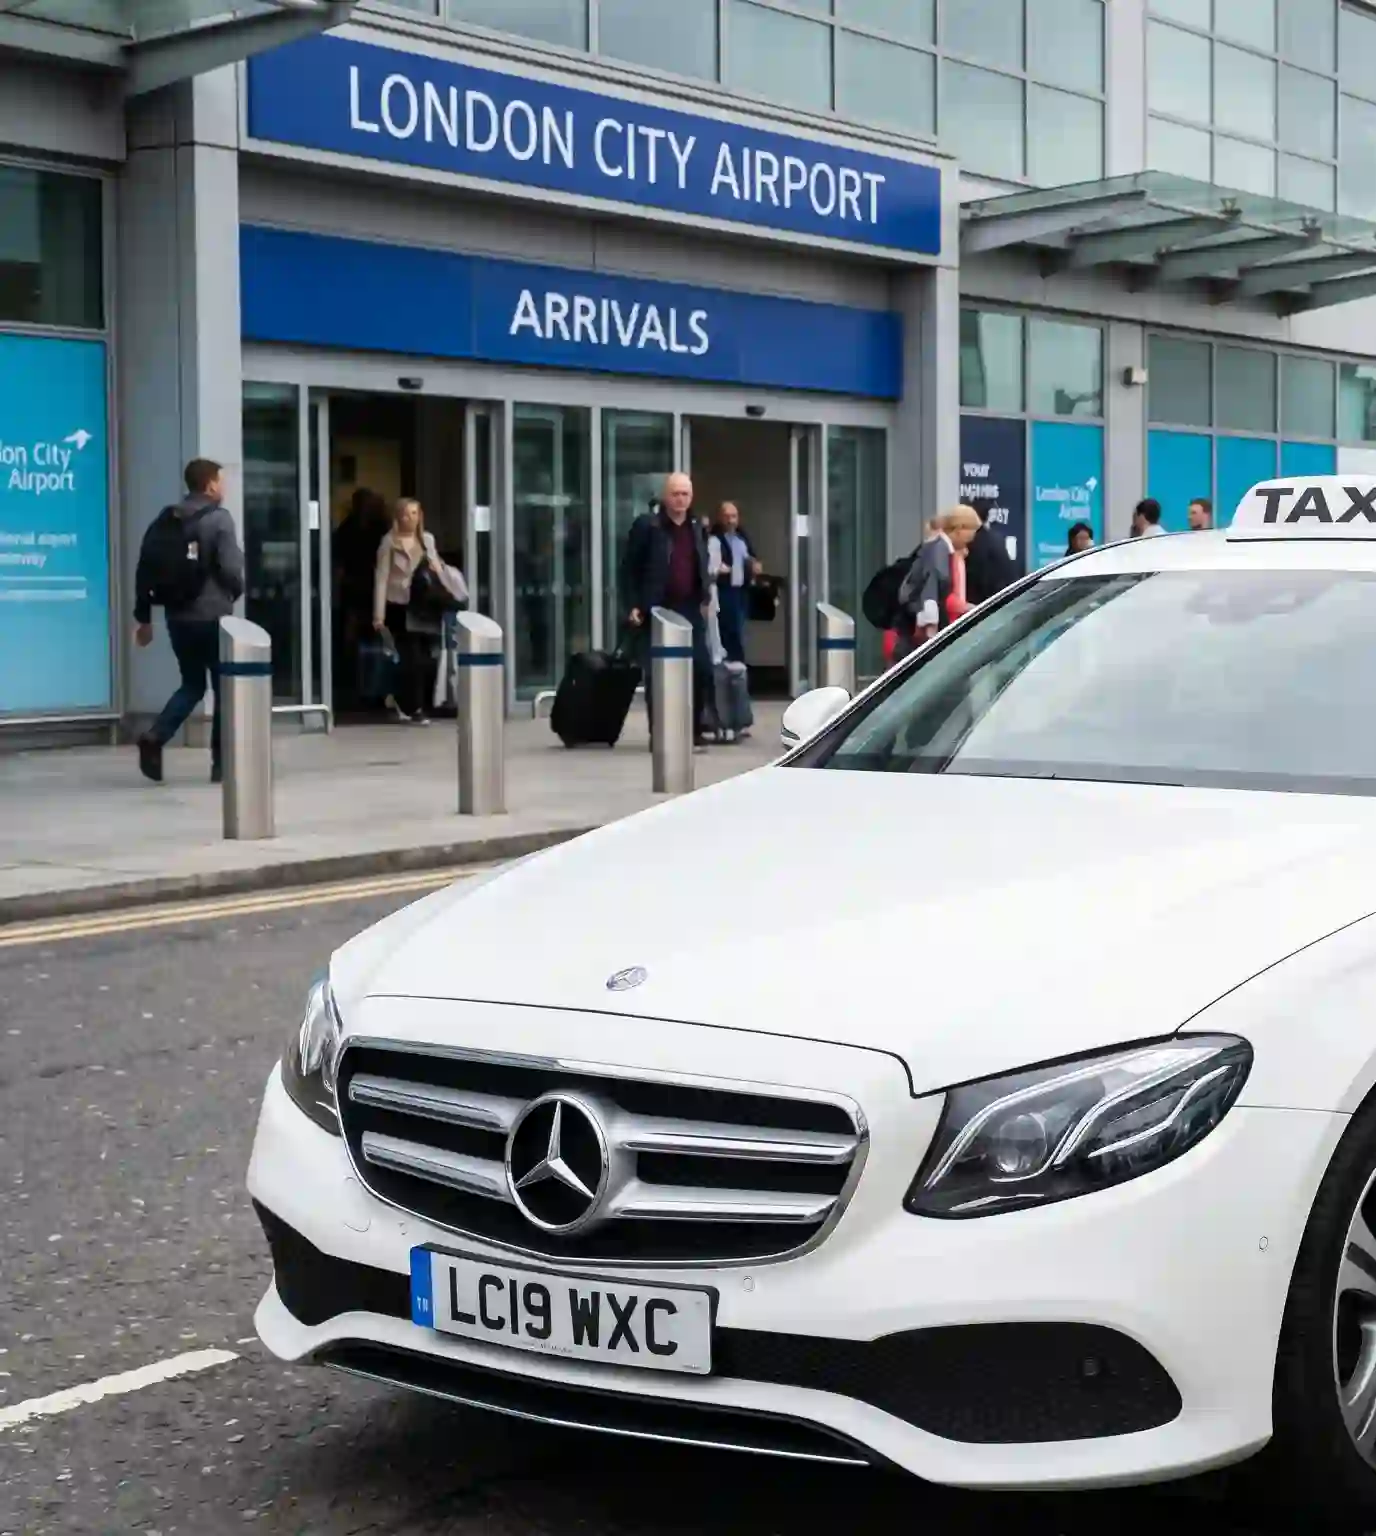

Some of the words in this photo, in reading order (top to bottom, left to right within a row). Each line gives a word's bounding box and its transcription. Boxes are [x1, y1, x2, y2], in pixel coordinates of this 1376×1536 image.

[350, 65, 574, 169] LONDON
[593, 117, 697, 190] CITY
[710, 141, 886, 225] AIRPORT
[509, 288, 710, 356] ARRIVALS
[8, 467, 76, 495] Airport
[33, 441, 72, 472] City
[449, 1266, 551, 1340] LC19
[568, 1287, 678, 1356] WXC
